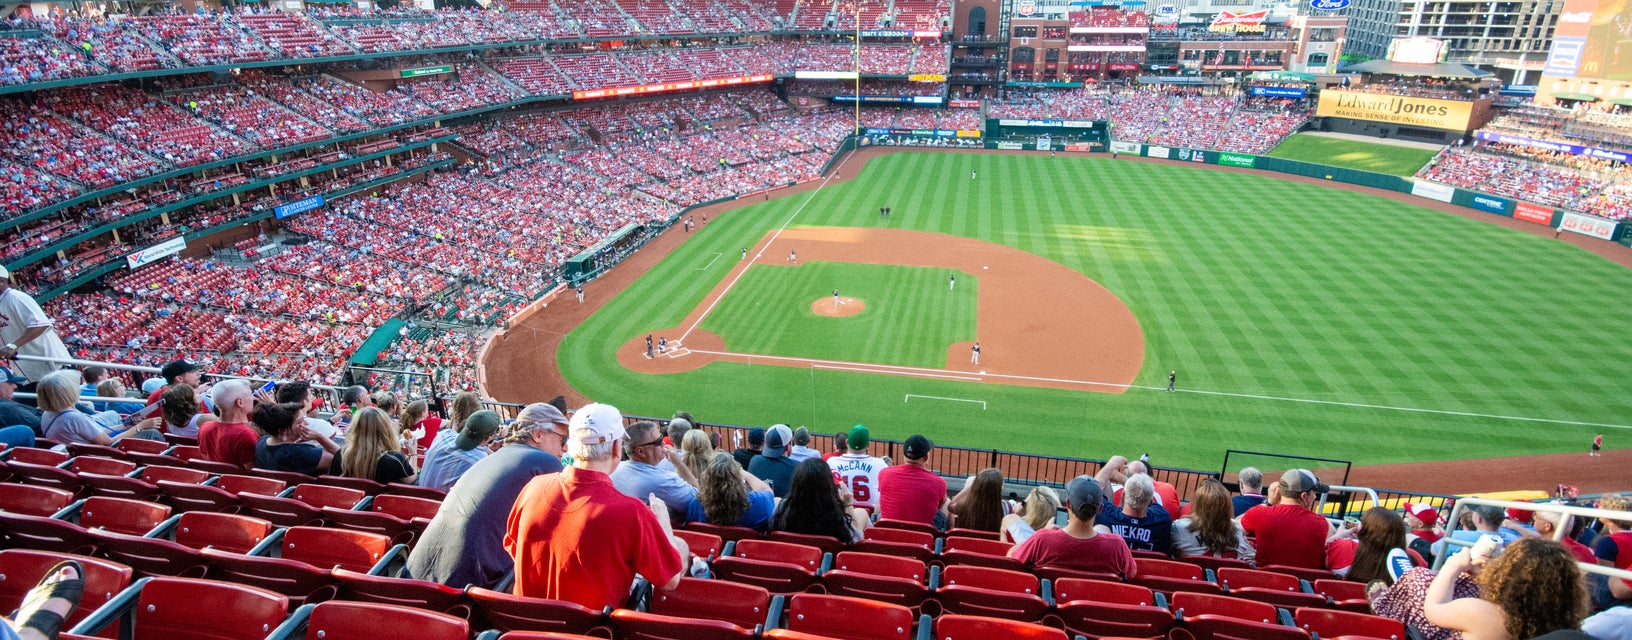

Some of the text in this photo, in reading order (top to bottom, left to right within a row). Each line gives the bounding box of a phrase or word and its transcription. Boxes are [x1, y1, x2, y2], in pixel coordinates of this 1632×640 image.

[1317, 0, 1343, 8] Ford
[1216, 13, 1267, 25] Budweiser
[1235, 24, 1267, 33] HOUSE
[1335, 110, 1362, 118] MAKING
[1365, 113, 1388, 121] SENSE
[1402, 117, 1444, 126] INVESTING
[290, 197, 317, 209] SITEMAN
[837, 461, 873, 474] McCANN
[1111, 525, 1152, 542] NIEKRO
